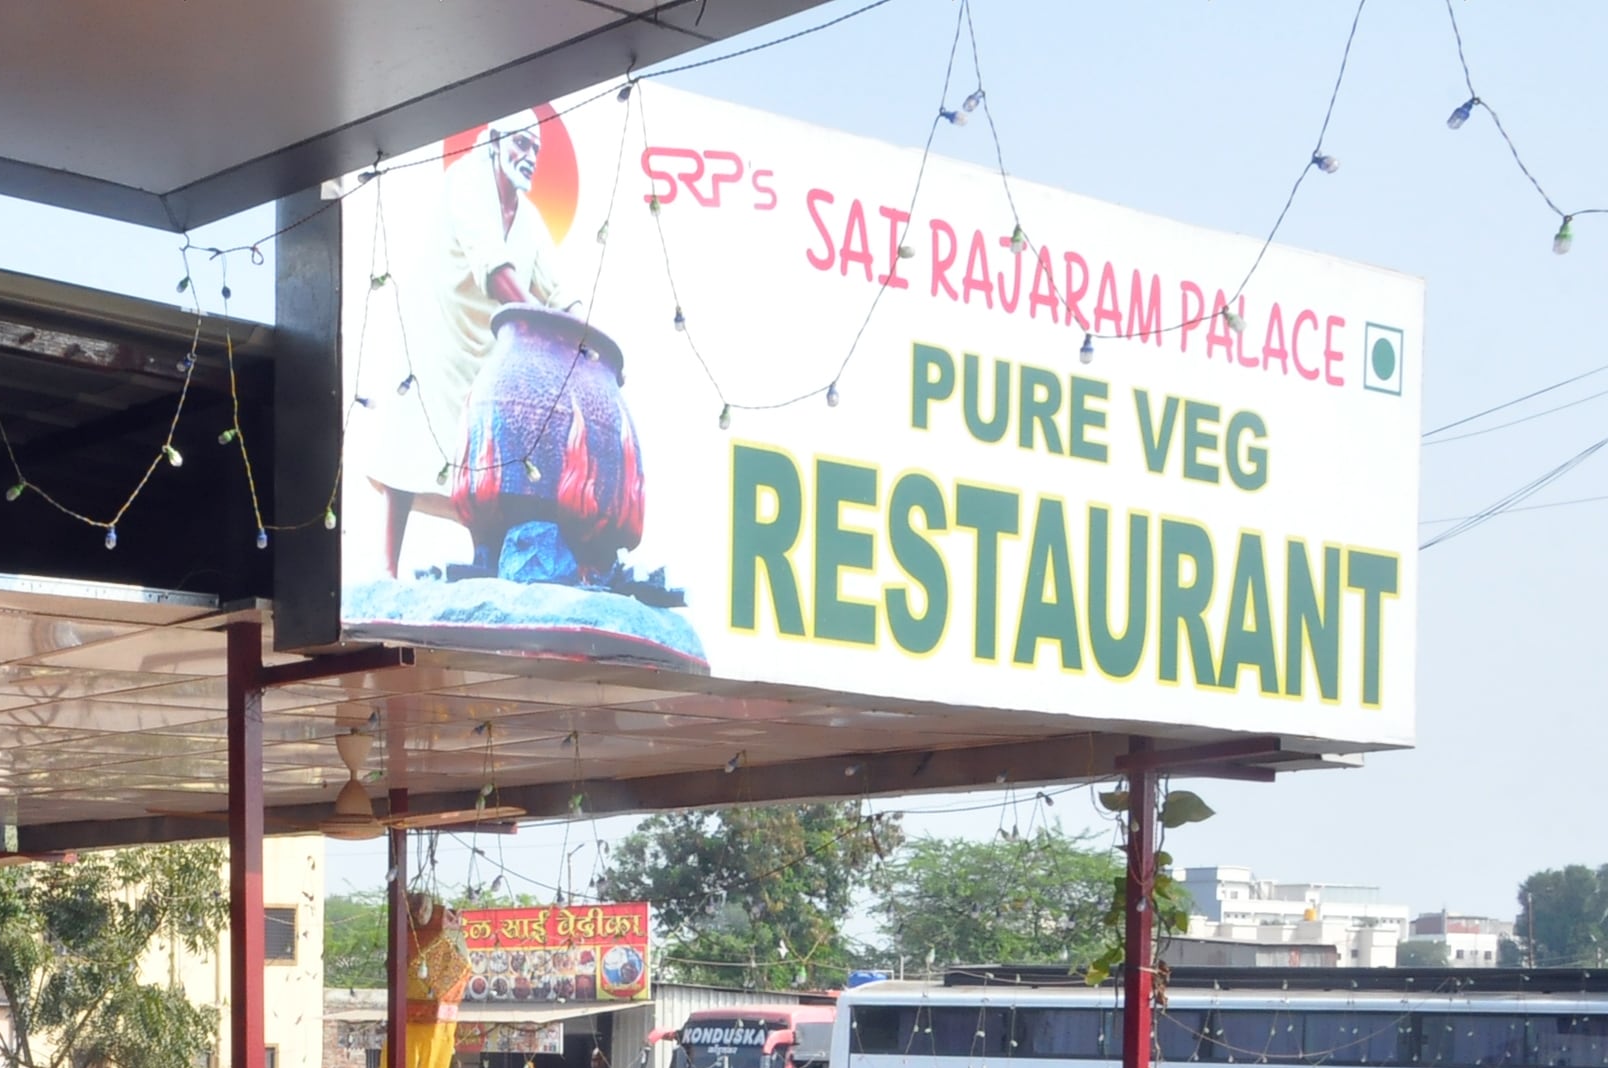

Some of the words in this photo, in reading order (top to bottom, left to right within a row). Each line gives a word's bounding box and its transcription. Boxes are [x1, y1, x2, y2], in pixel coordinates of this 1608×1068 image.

[806, 187, 912, 290] SAI
[929, 217, 1163, 348] RAJARAM
[1180, 279, 1347, 387] PALACE
[909, 339, 1110, 465] PURE
[1131, 386, 1270, 493] VEG
[729, 438, 1401, 710] RESTAURANT
[682, 1026, 770, 1045] KONDUSKA
